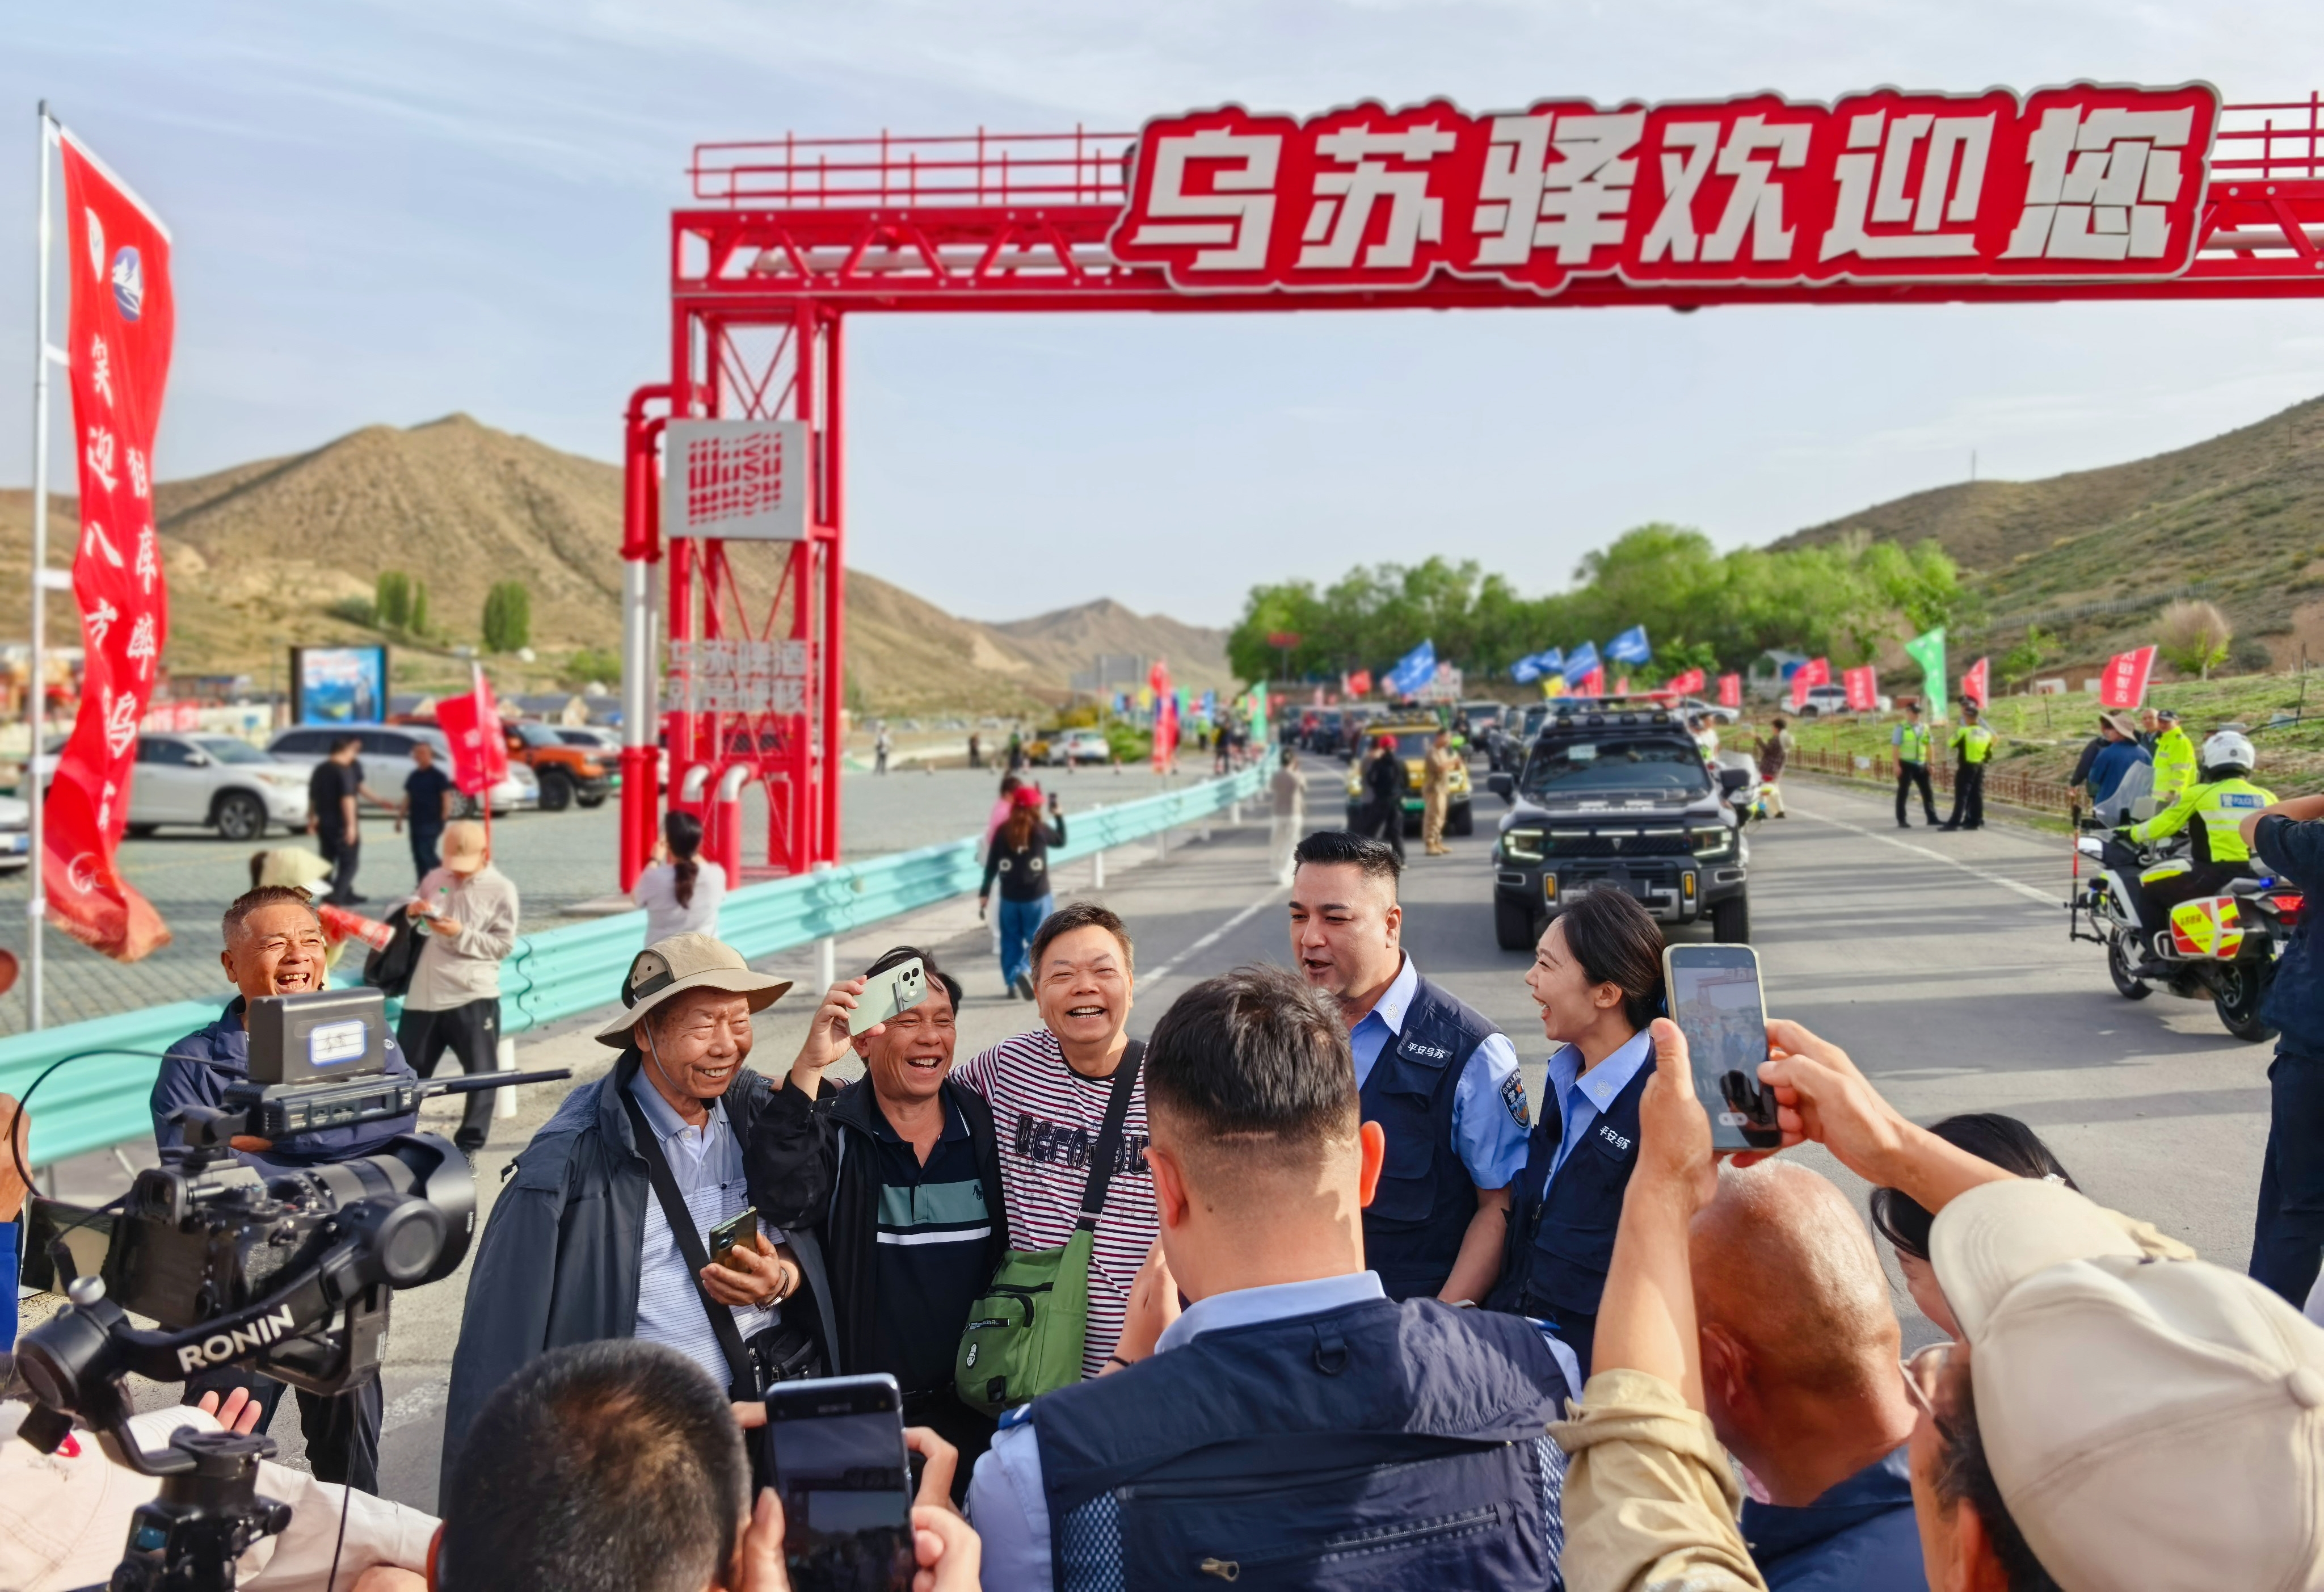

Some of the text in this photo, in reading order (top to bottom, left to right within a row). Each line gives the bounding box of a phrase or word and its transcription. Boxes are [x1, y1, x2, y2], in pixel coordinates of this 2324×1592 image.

[1129, 103, 2195, 270] 乌苏驿欢迎您
[1408, 1042, 1445, 1059] 平安乌苏
[176, 1303, 295, 1375] RONIN
